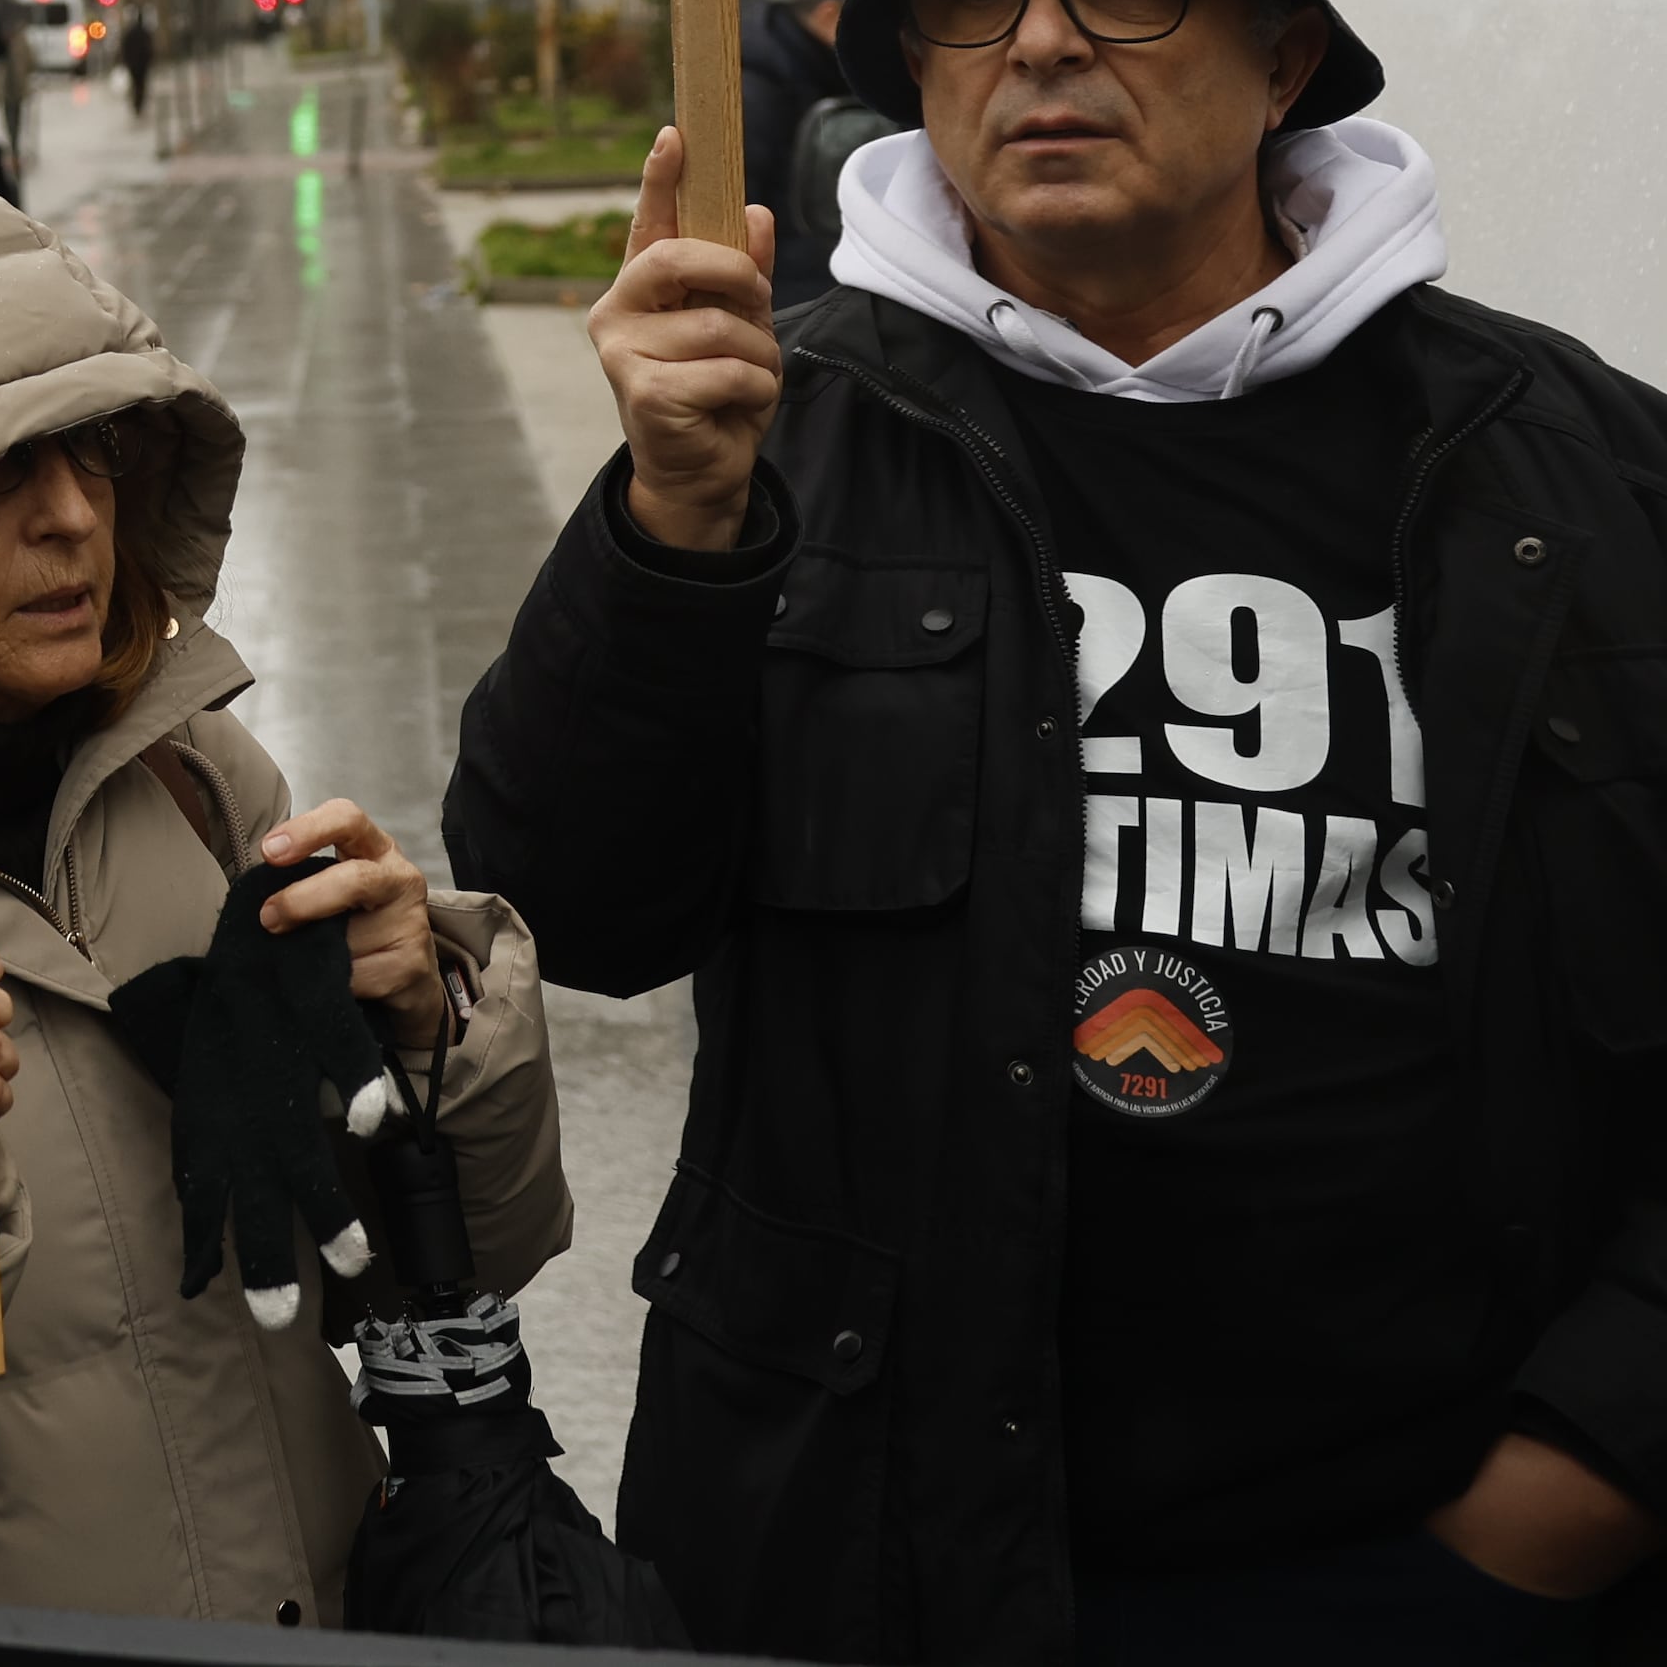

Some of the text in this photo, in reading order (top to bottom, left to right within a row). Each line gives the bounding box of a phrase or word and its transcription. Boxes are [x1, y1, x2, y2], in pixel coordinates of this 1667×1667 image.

[1134, 950, 1146, 972] Y
[1154, 954, 1228, 1032] JUSTICIA
[1120, 1073, 1167, 1099] 7291
